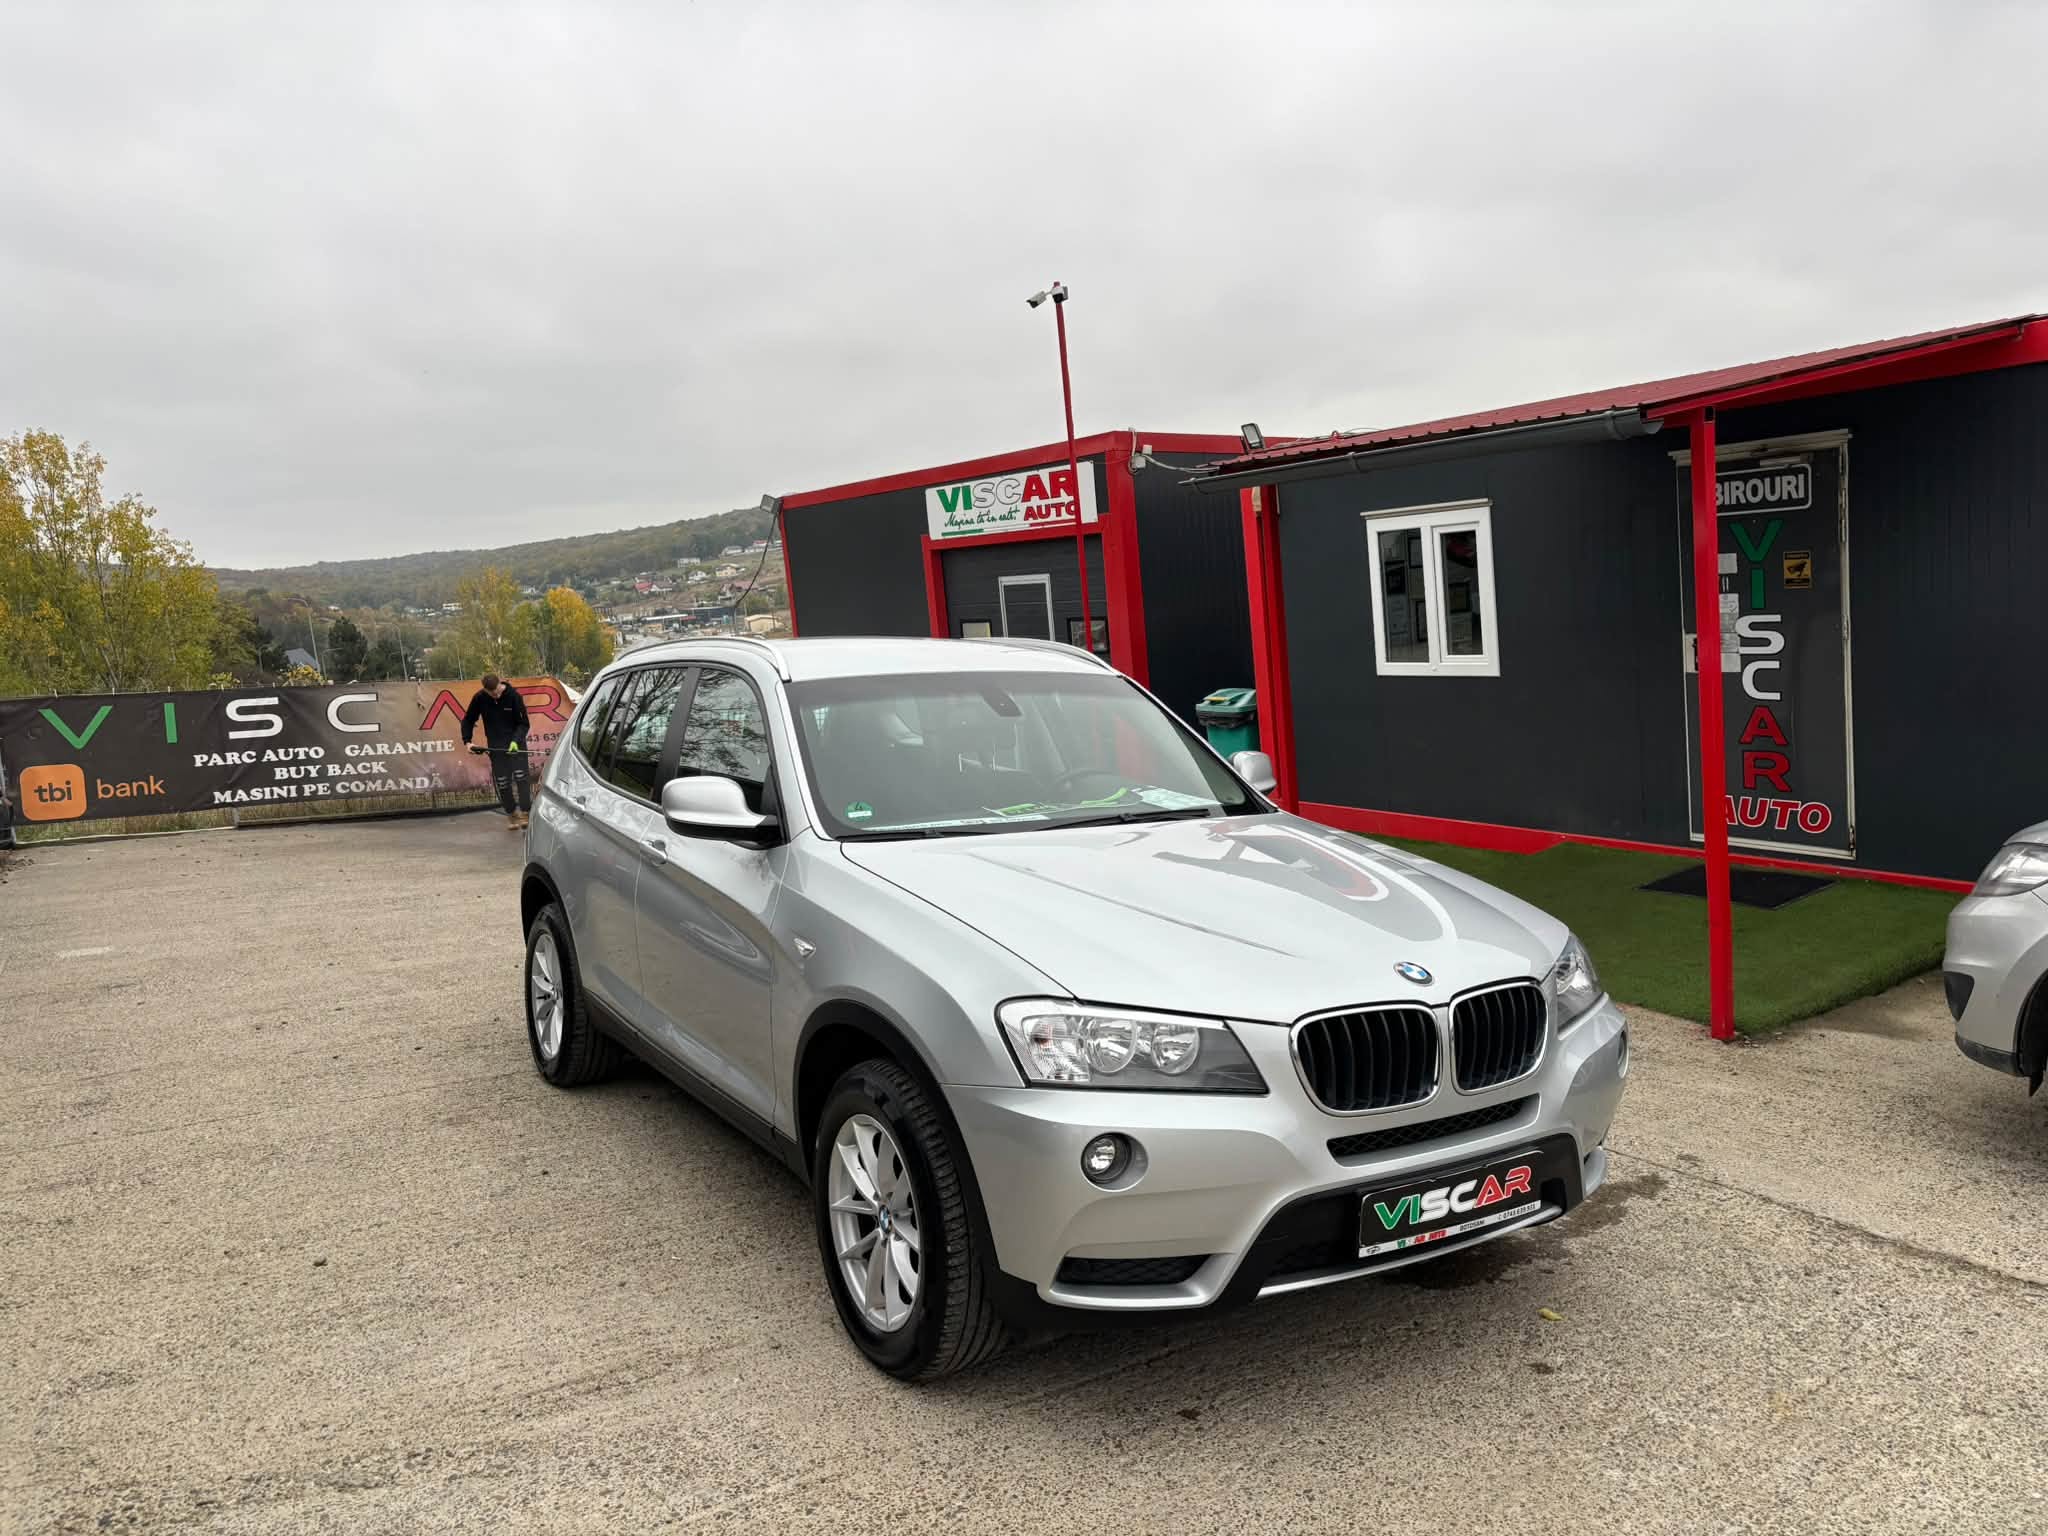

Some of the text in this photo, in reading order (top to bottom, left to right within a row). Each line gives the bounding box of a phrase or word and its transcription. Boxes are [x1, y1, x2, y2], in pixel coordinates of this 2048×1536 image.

[936, 469, 1076, 513] VISCAR
[1728, 519, 1793, 793] VISCAR
[38, 684, 569, 750] VISCAR
[193, 739, 455, 767] PARC AUTO GARANTIE
[273, 760, 388, 780] BUY BACK
[33, 775, 167, 804] tbi bank
[213, 785, 297, 804] MASINI
[303, 782, 332, 798] PE
[1373, 1165, 1532, 1230] VISCAR
